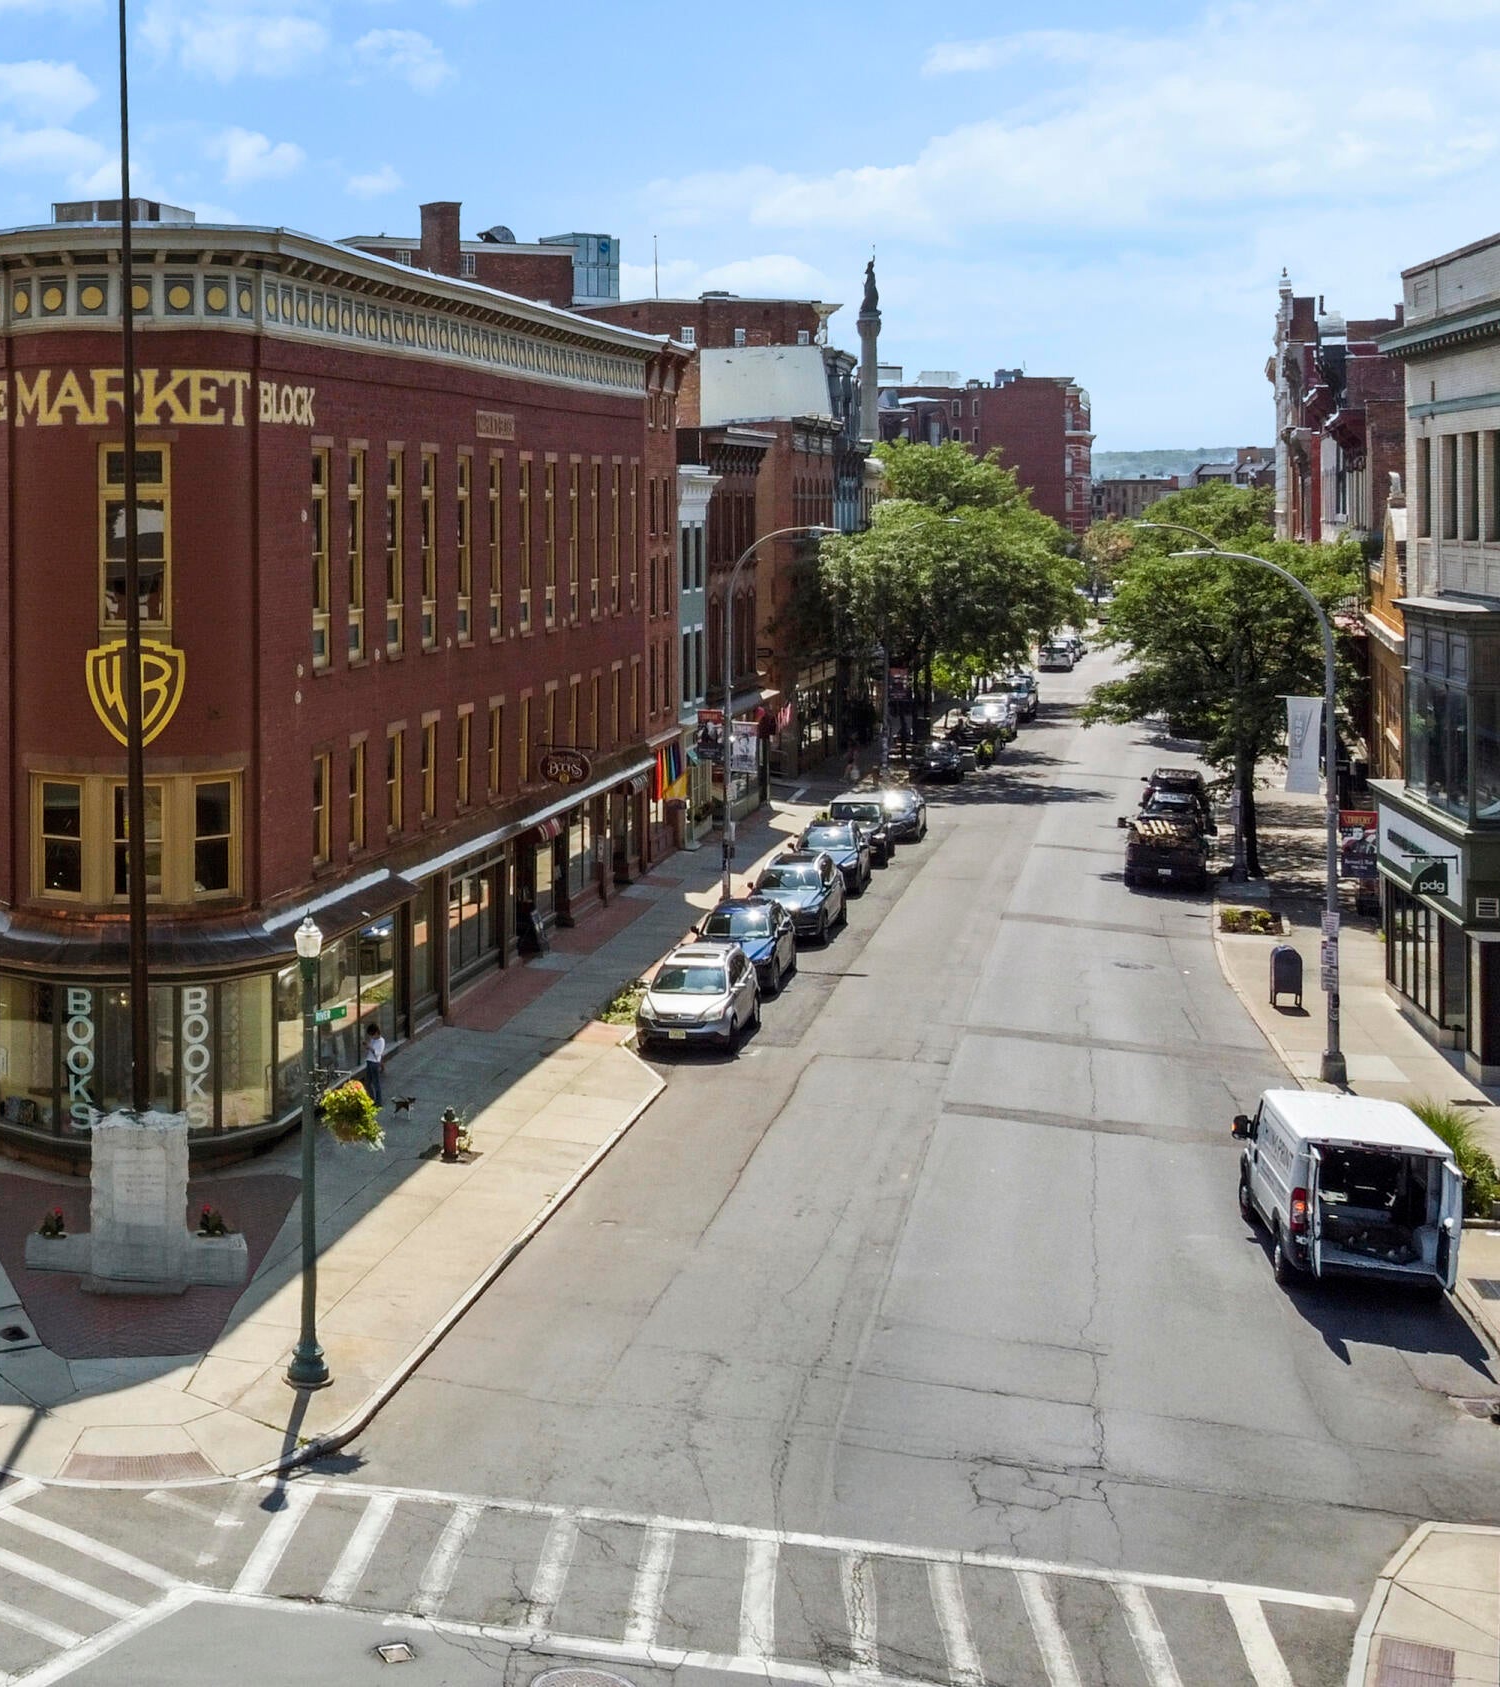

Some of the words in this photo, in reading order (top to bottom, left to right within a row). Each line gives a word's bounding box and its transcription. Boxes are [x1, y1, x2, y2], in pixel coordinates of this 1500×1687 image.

[15, 368, 250, 427] MARKET
[259, 381, 315, 427] BLOCK
[99, 653, 172, 731] WB
[1420, 880, 1445, 893] pdg
[66, 987, 95, 1130] BOOKS
[182, 987, 210, 1129] BOOKS
